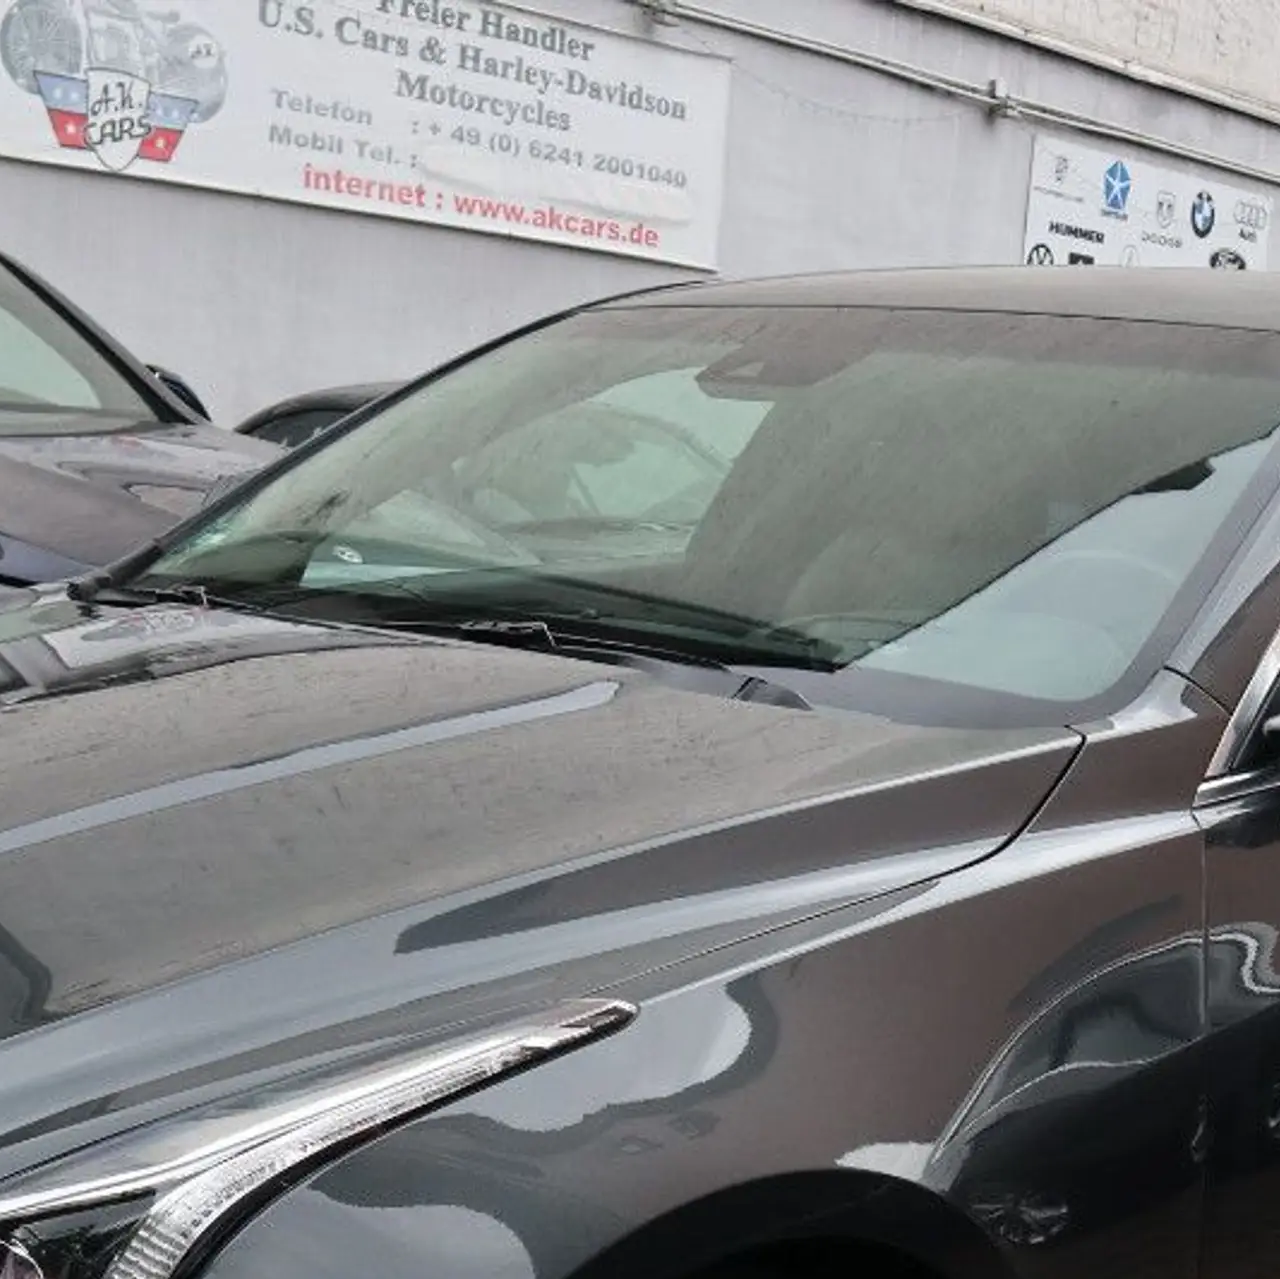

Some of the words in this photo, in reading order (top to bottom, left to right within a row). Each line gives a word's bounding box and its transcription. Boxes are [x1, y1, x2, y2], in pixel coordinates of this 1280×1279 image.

[258, 0, 324, 38] U.S.
[335, 16, 409, 56] Cars
[419, 35, 447, 65] &
[457, 43, 686, 120] Harley-Davidson
[84, 114, 152, 145] CARS
[394, 69, 571, 131] Motorcycles
[268, 125, 343, 154] Mobil
[353, 140, 402, 165] Tel.
[270, 89, 372, 125] Telefon
[450, 124, 480, 146] 49
[490, 132, 520, 157] (0)
[528, 139, 585, 168] 6241
[592, 153, 688, 188] 2001040
[303, 162, 427, 208] internet
[453, 192, 659, 247] www.akcars.de
[1048, 219, 1105, 244] HUMMER
